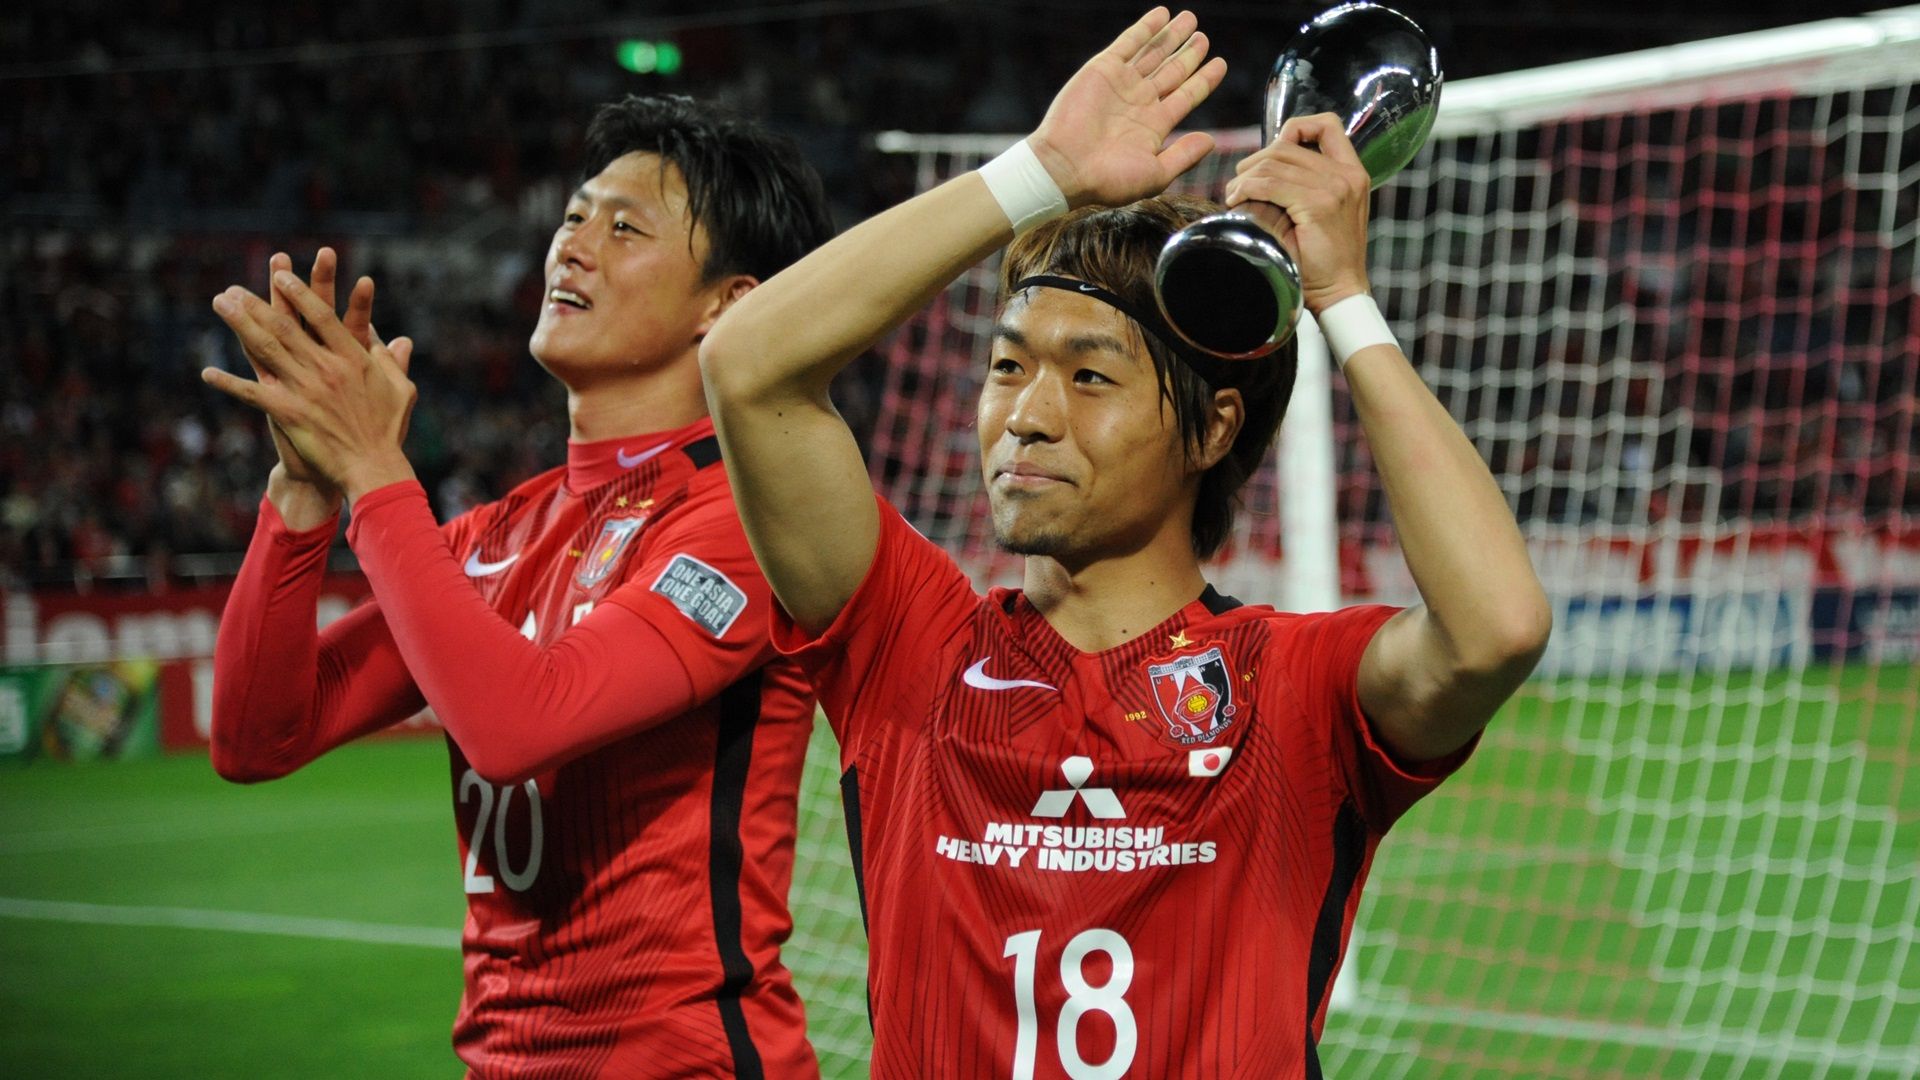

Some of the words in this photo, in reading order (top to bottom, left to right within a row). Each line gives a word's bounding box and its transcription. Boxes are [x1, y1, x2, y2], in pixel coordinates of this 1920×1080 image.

[661, 578, 693, 601] ONE
[690, 592, 724, 629] GOAL
[672, 563, 702, 587] ONE
[700, 578, 734, 613] ASIA
[1124, 711, 1147, 722] 1992
[459, 768, 543, 894] 20
[936, 835, 1028, 868] HEAVY
[1038, 841, 1217, 872] INDUSTRIES
[985, 822, 1164, 850] MITSUBISHI
[1003, 928, 1138, 1080] 18
